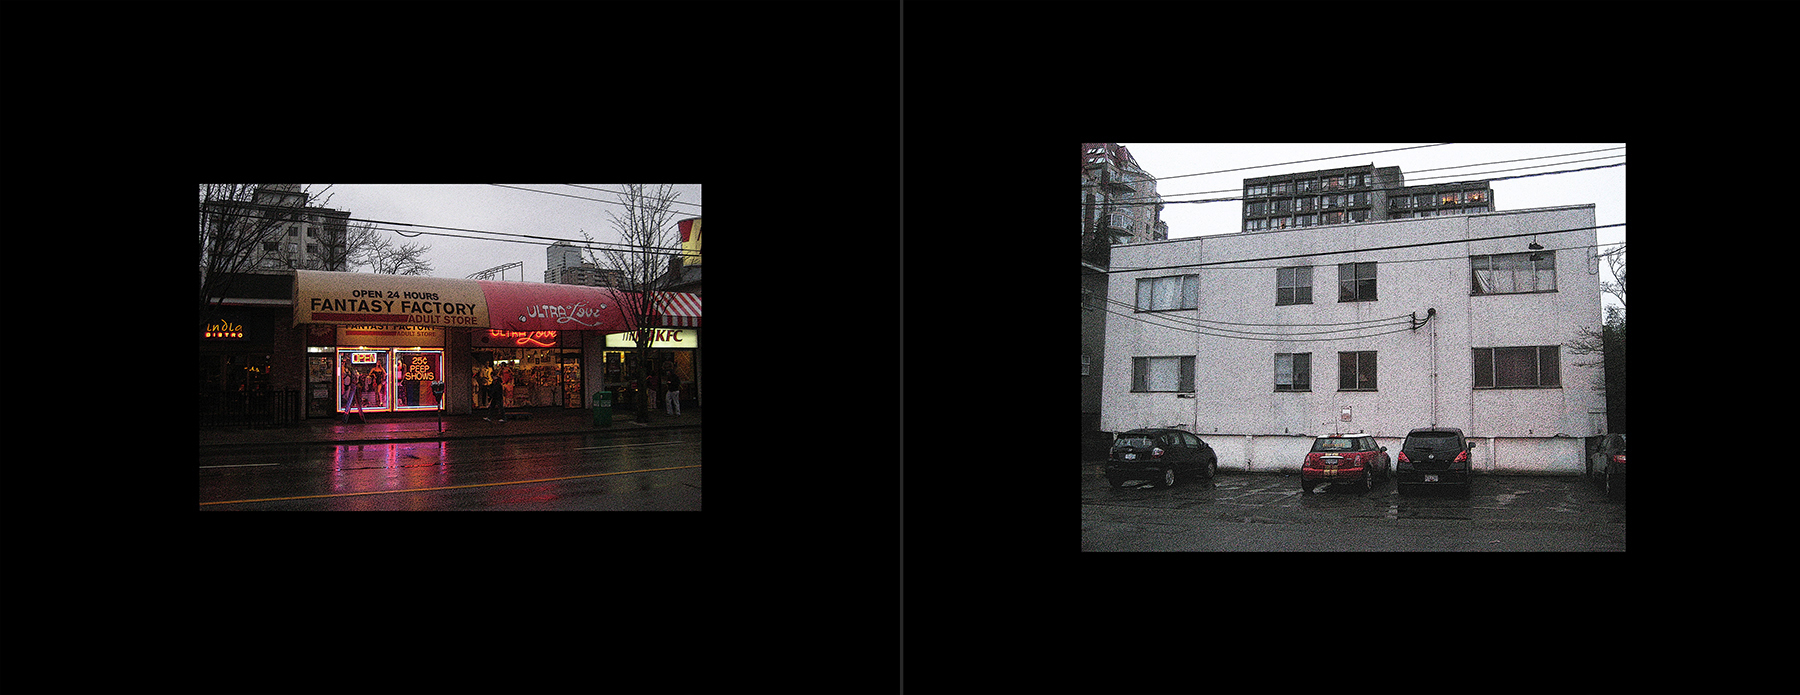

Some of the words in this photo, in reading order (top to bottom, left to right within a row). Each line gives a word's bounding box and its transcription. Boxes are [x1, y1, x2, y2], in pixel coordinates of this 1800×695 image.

[352, 290, 383, 299] OPEN
[387, 290, 400, 299] 24
[403, 292, 439, 301] HOURS
[311, 298, 394, 313] FANTASY
[401, 300, 476, 316] FACTORY
[526, 304, 567, 318] ULTRA
[557, 299, 603, 327] Love
[407, 314, 441, 324] ADULT
[443, 316, 478, 325] STORE
[655, 329, 683, 342] KFC
[353, 353, 376, 363] OPEN
[411, 356, 428, 365] 25¢
[409, 364, 430, 373] PEEP
[405, 372, 435, 381] SHOWS
